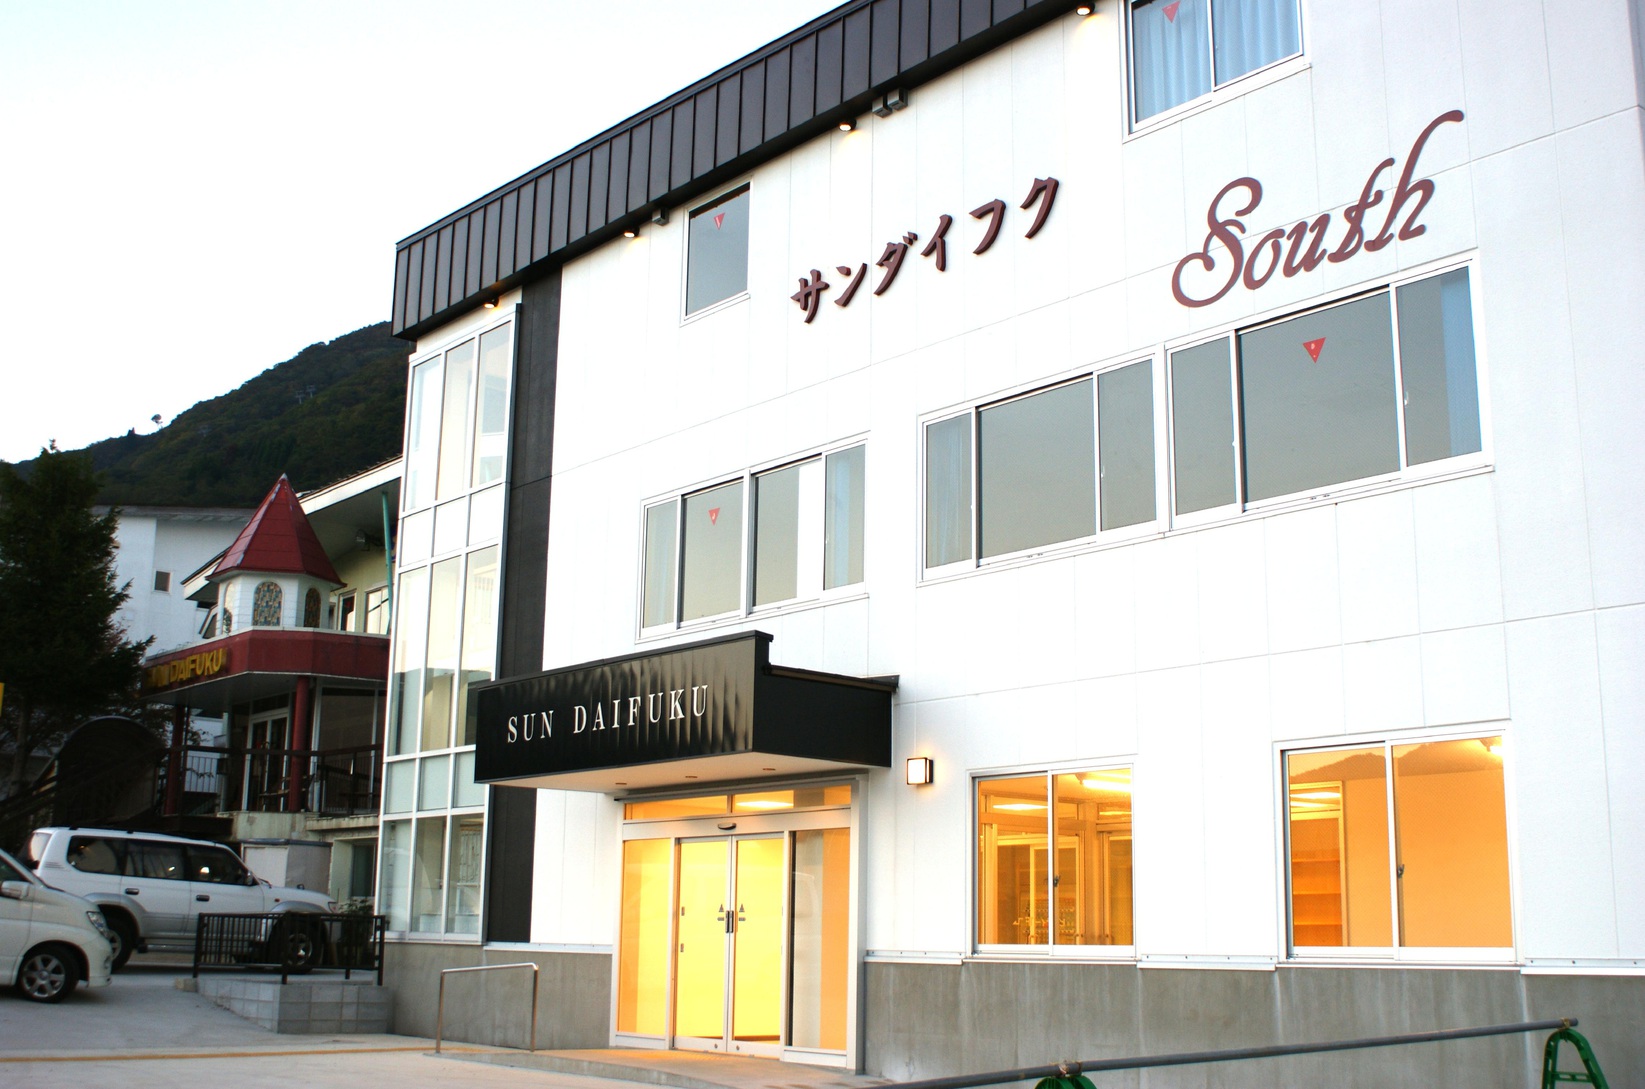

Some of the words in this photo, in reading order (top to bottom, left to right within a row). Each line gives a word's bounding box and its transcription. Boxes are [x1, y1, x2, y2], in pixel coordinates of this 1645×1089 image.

[790, 176, 1060, 324] サンダイフク
[1171, 109, 1464, 308] South
[170, 648, 224, 683] DAIFUKU
[507, 710, 555, 743] SUN
[573, 684, 710, 734] DAIFUKU
